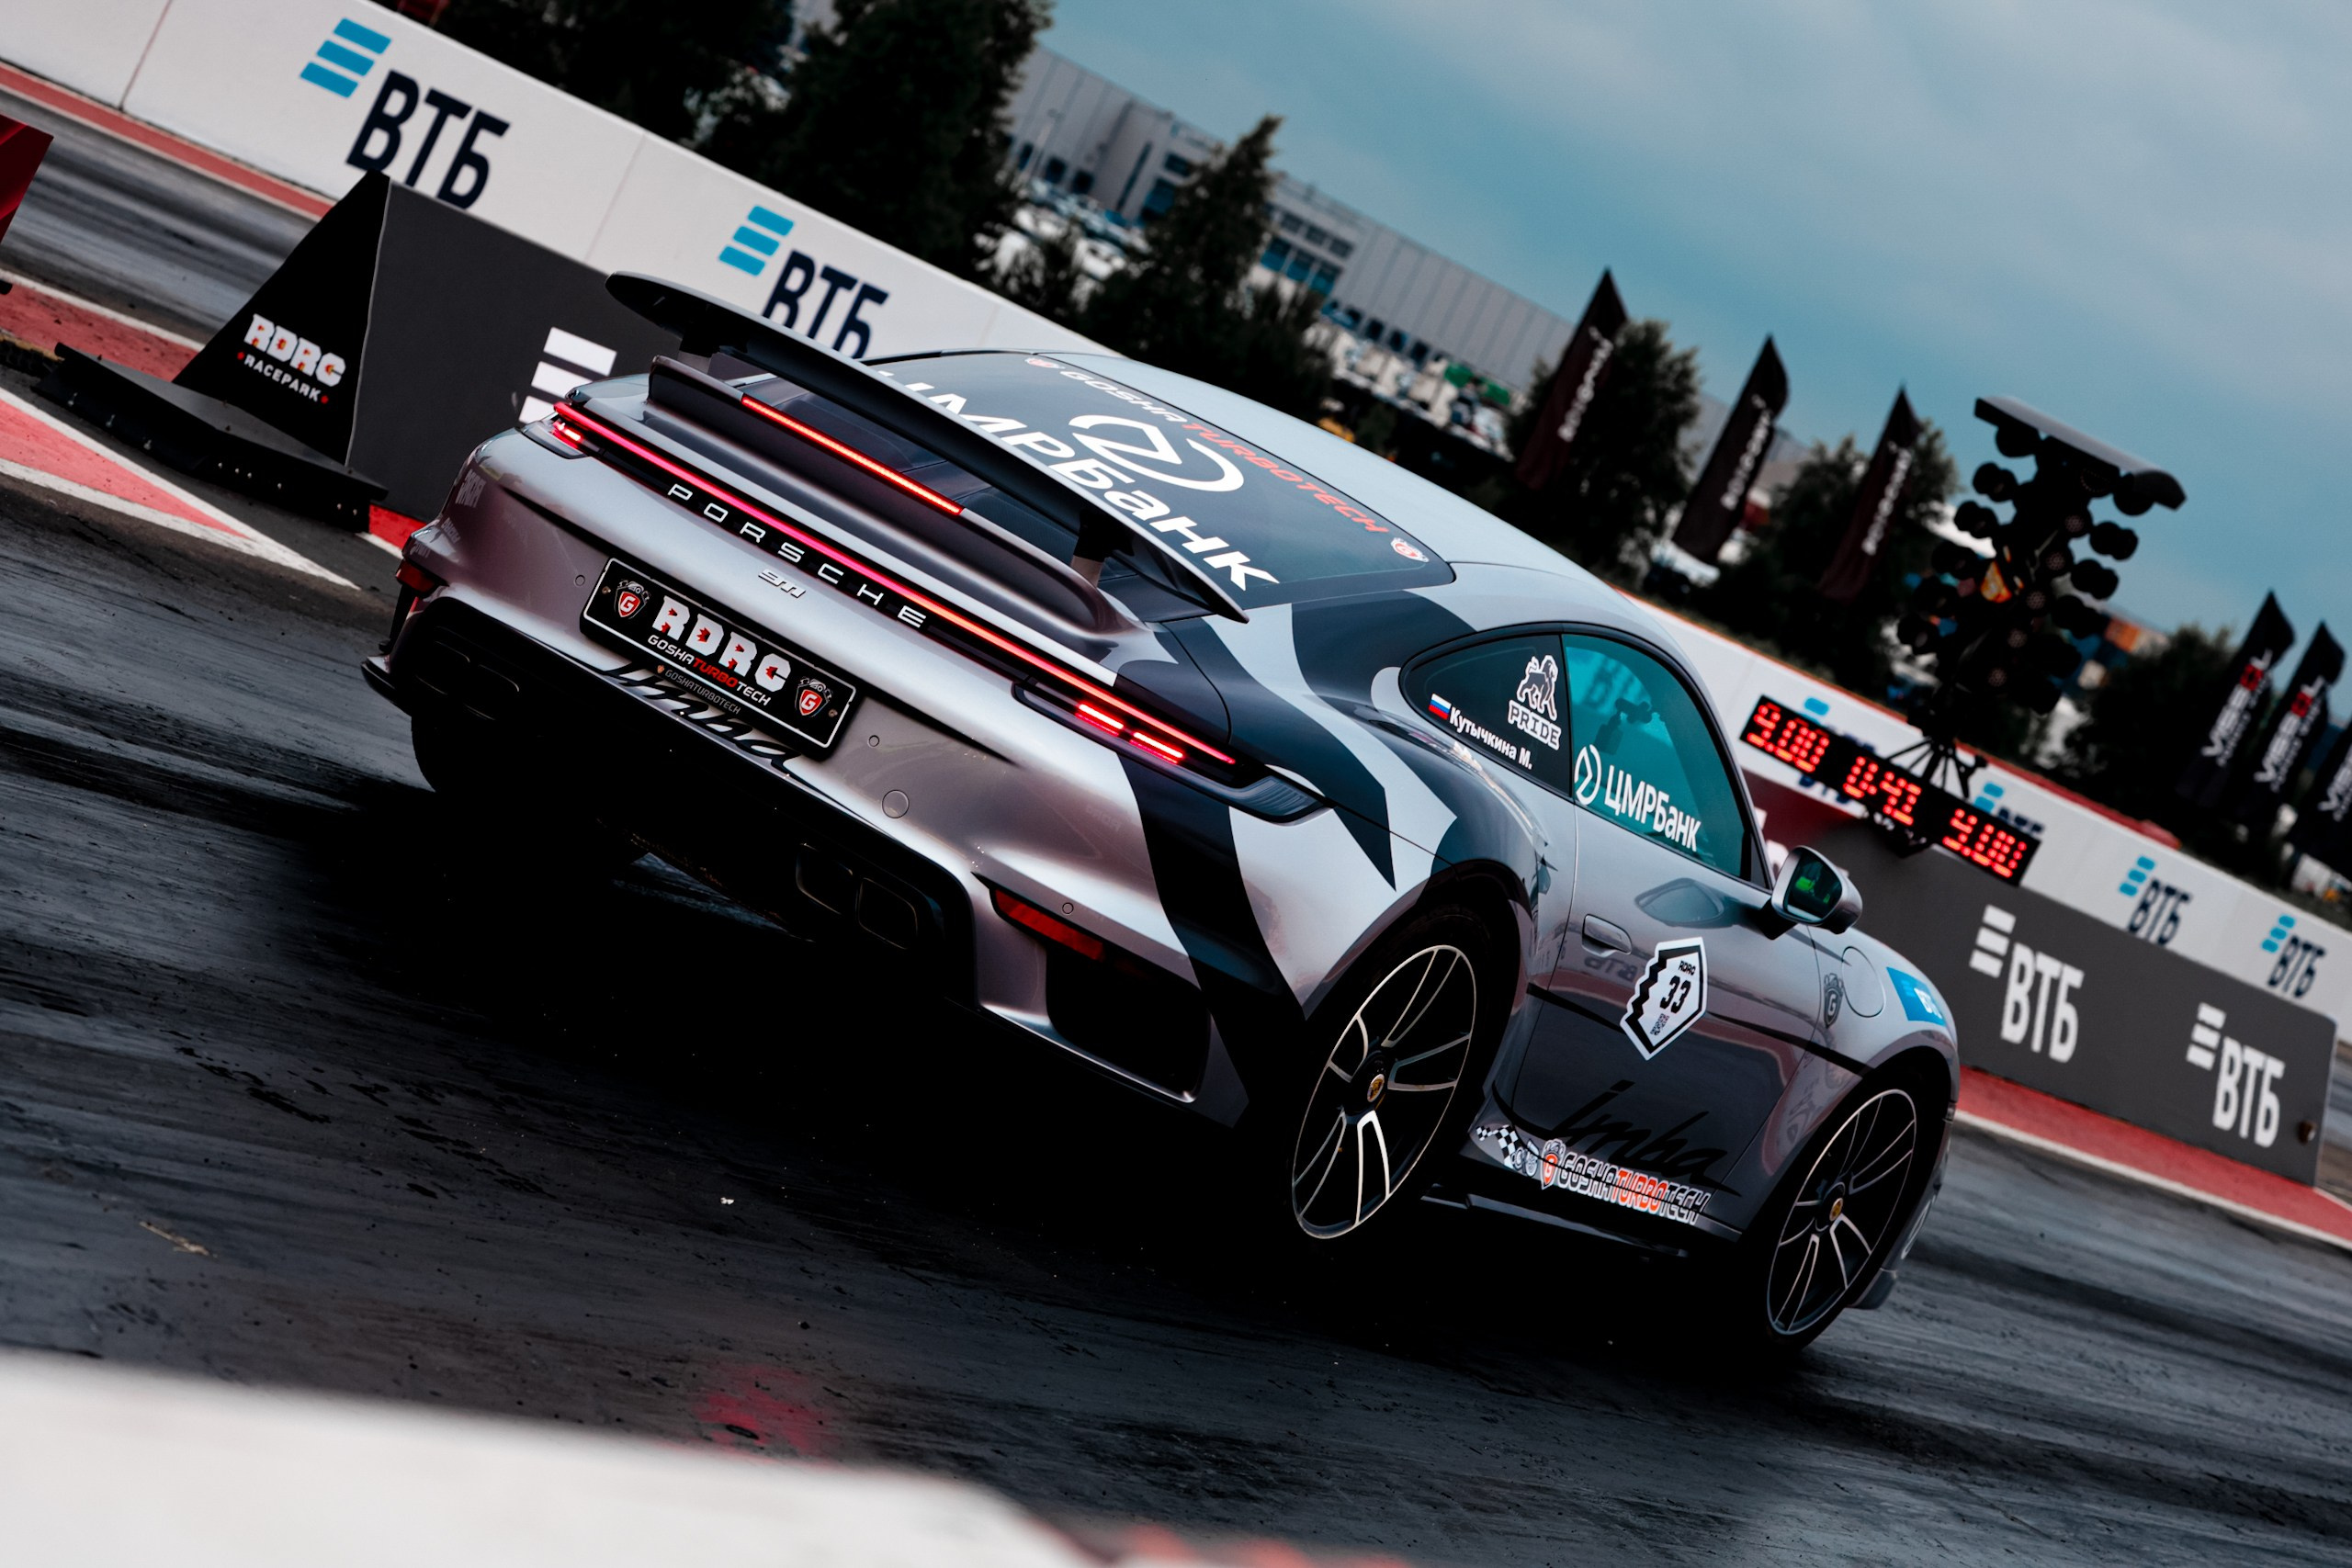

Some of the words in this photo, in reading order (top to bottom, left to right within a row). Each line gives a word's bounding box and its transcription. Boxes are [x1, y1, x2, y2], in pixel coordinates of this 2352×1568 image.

[345, 69, 510, 210] ВТБ
[762, 249, 889, 360] ВТБ
[243, 354, 322, 402] RACEPARK
[668, 483, 926, 627] PORSCHE
[758, 568, 806, 599] 911
[647, 633, 772, 706] GOSHATURBOTECH
[664, 669, 741, 716] GOSHATURBOTECH
[1450, 706, 1517, 760] Кутычкина
[1519, 747, 1533, 770] М.
[1508, 700, 1561, 750] PRIDE
[1604, 765, 1702, 852] ЦМРБанк
[2127, 878, 2192, 946] ВТБ
[1659, 976, 1690, 1014] 33
[2267, 937, 2326, 998] ВТБ
[2000, 943, 2085, 1063] ВТБ
[2212, 1037, 2285, 1148] ВТБ
[1557, 1151, 1711, 1225] GOSHATURBOTECH
